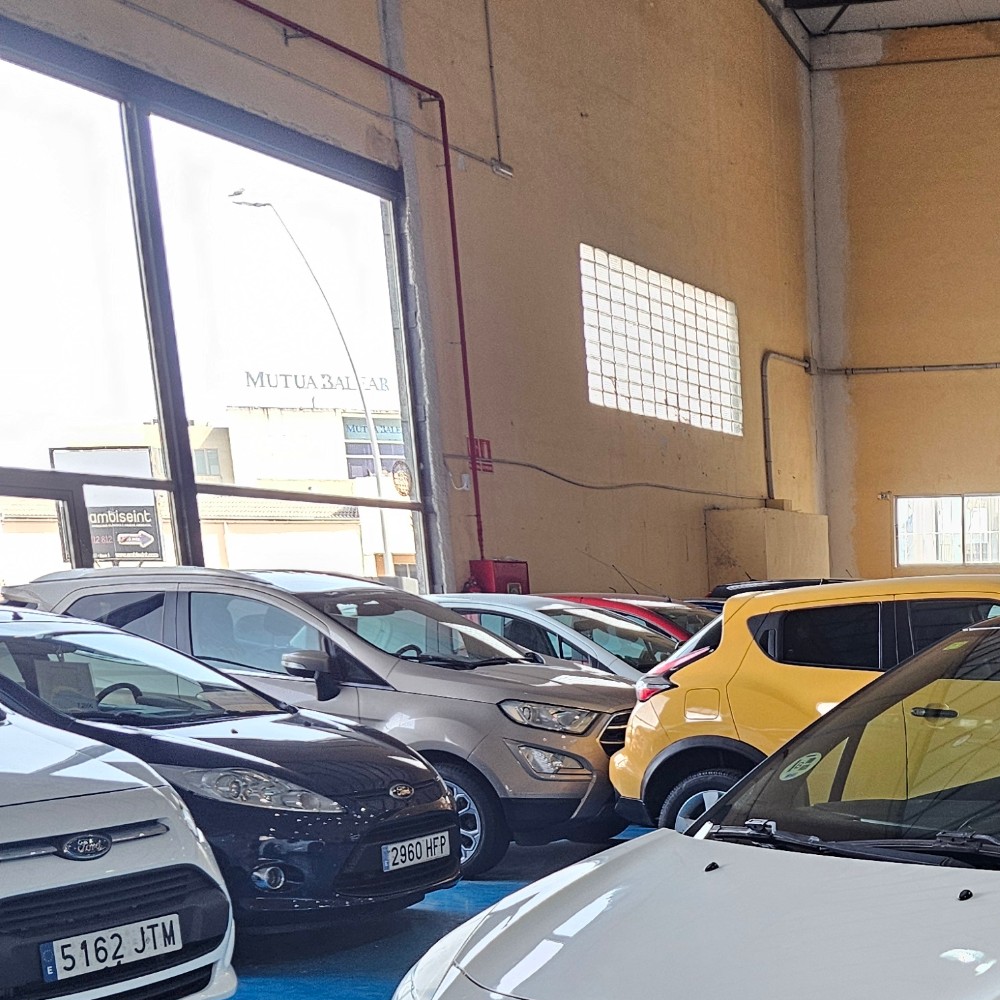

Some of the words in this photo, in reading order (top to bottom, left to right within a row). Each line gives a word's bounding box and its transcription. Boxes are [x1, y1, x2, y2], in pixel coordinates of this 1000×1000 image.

[245, 371, 317, 389] MUTUA
[89, 509, 152, 524] ambiseint
[77, 838, 107, 853] Ford
[391, 841, 423, 867] 2960
[425, 835, 447, 857] HFP
[60, 933, 124, 971] 5162
[134, 920, 176, 954] JTM
[47, 966, 53, 975] E
